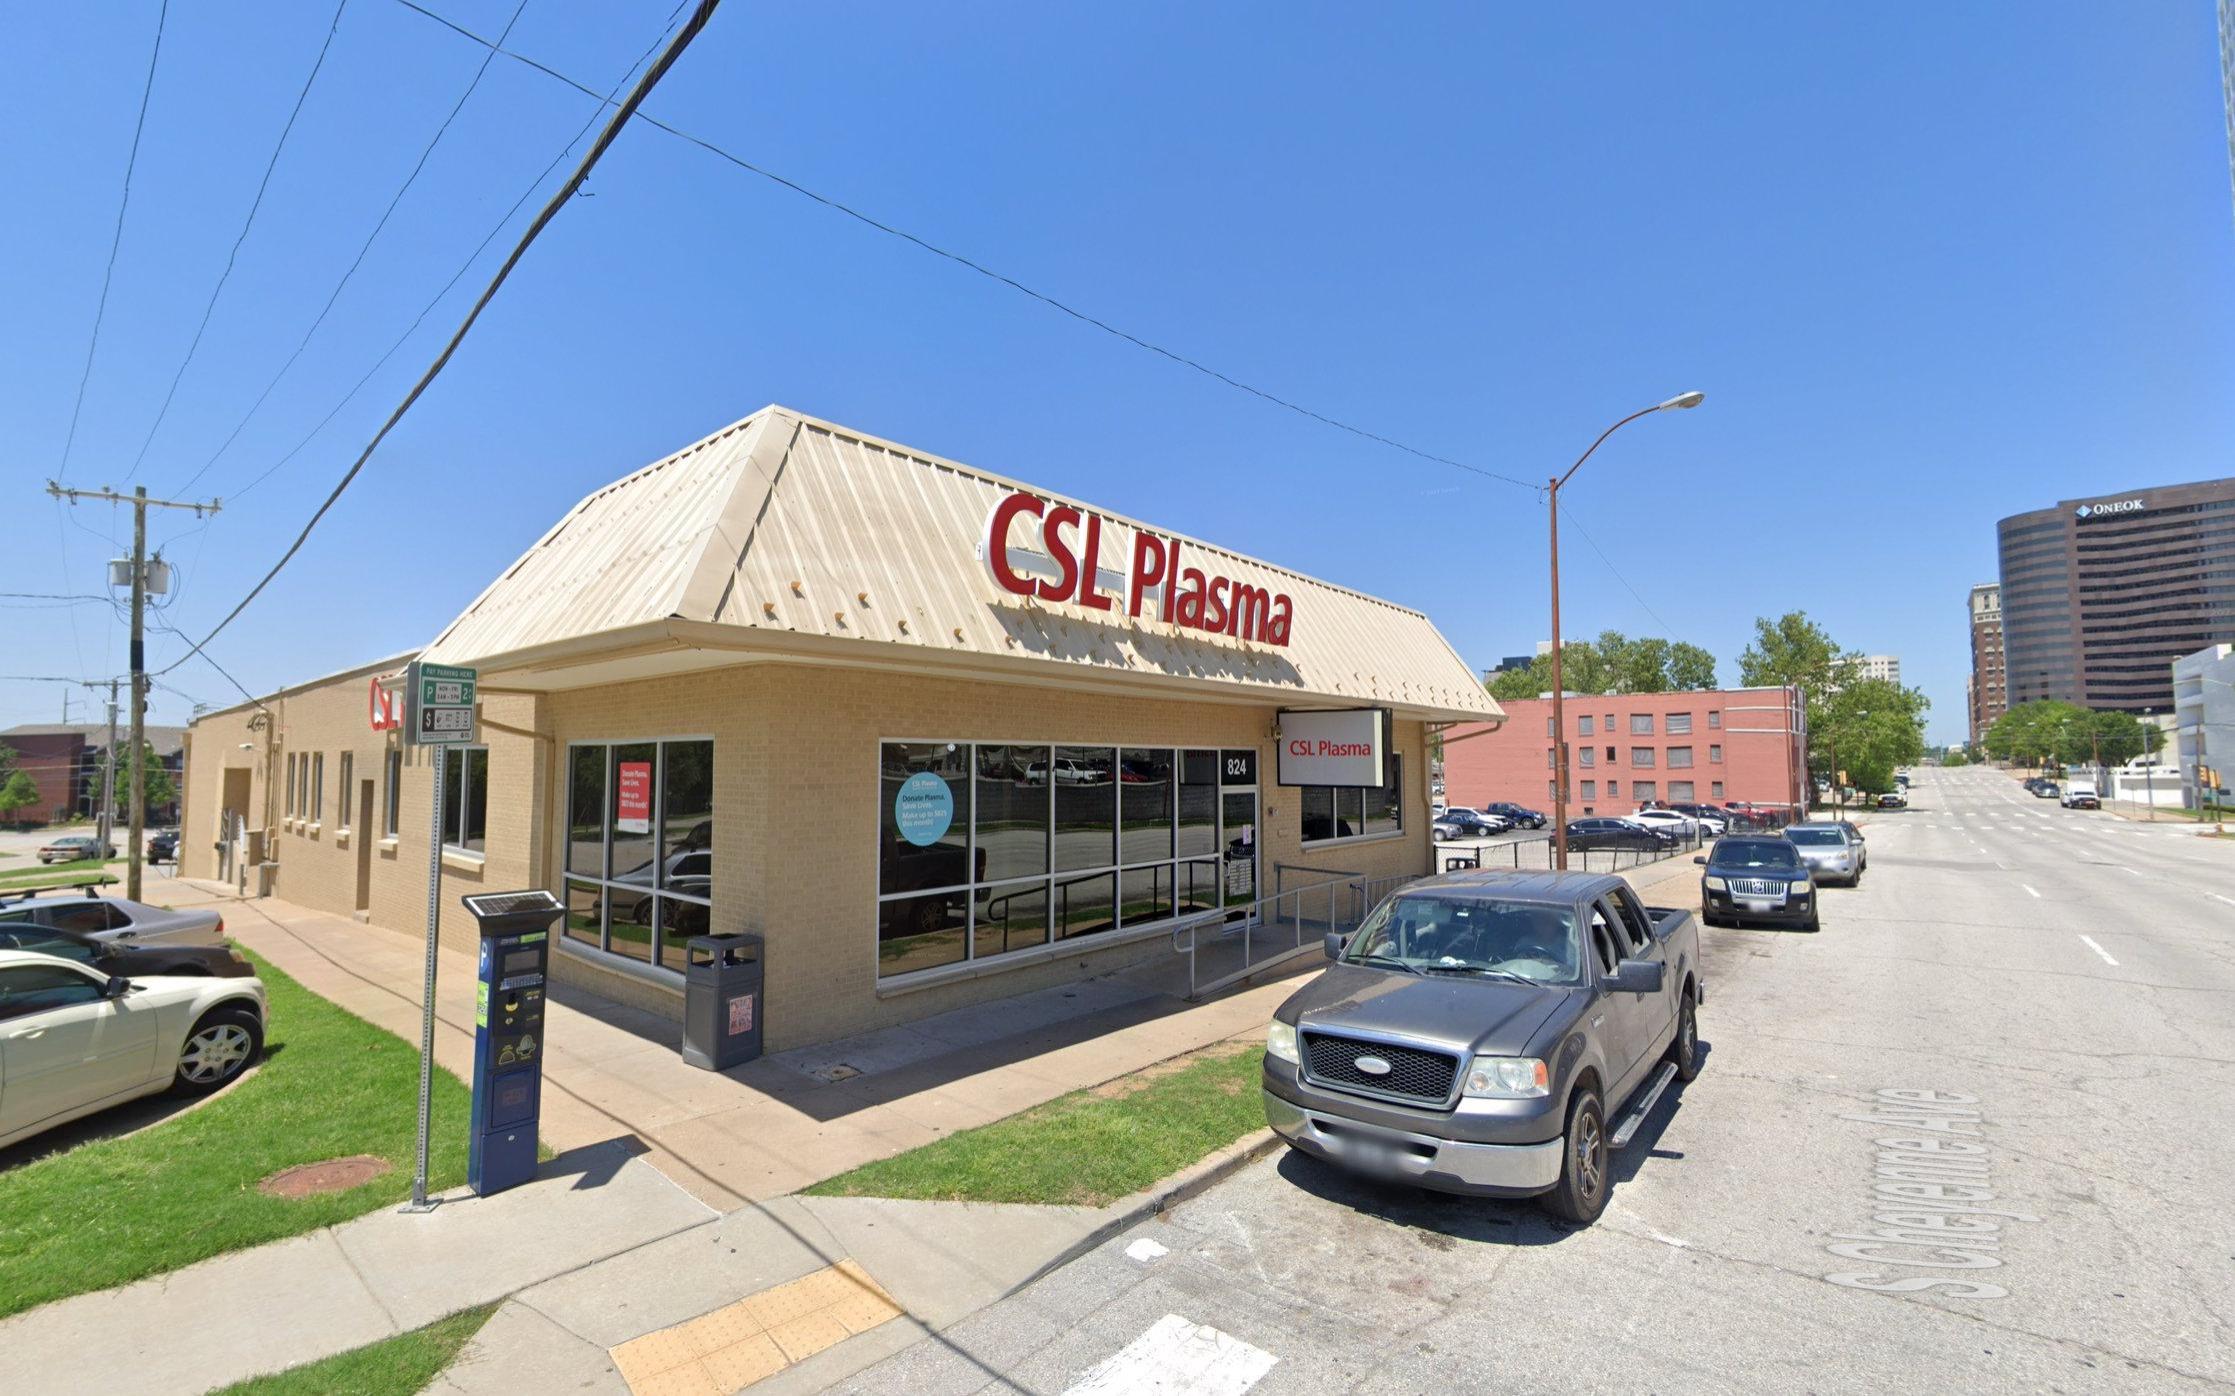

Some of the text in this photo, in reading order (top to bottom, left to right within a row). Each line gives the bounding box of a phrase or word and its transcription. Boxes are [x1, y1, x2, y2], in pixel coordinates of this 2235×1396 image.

[2093, 499, 2144, 515] ONEOK
[988, 492, 1293, 647] CSL Plasma
[426, 667, 436, 675] PAY
[437, 669, 459, 677] PARKING
[427, 686, 434, 699] P
[1289, 740, 1371, 756] CSL Plasma
[1227, 758, 1247, 775] 824
[902, 794, 923, 802] Donate
